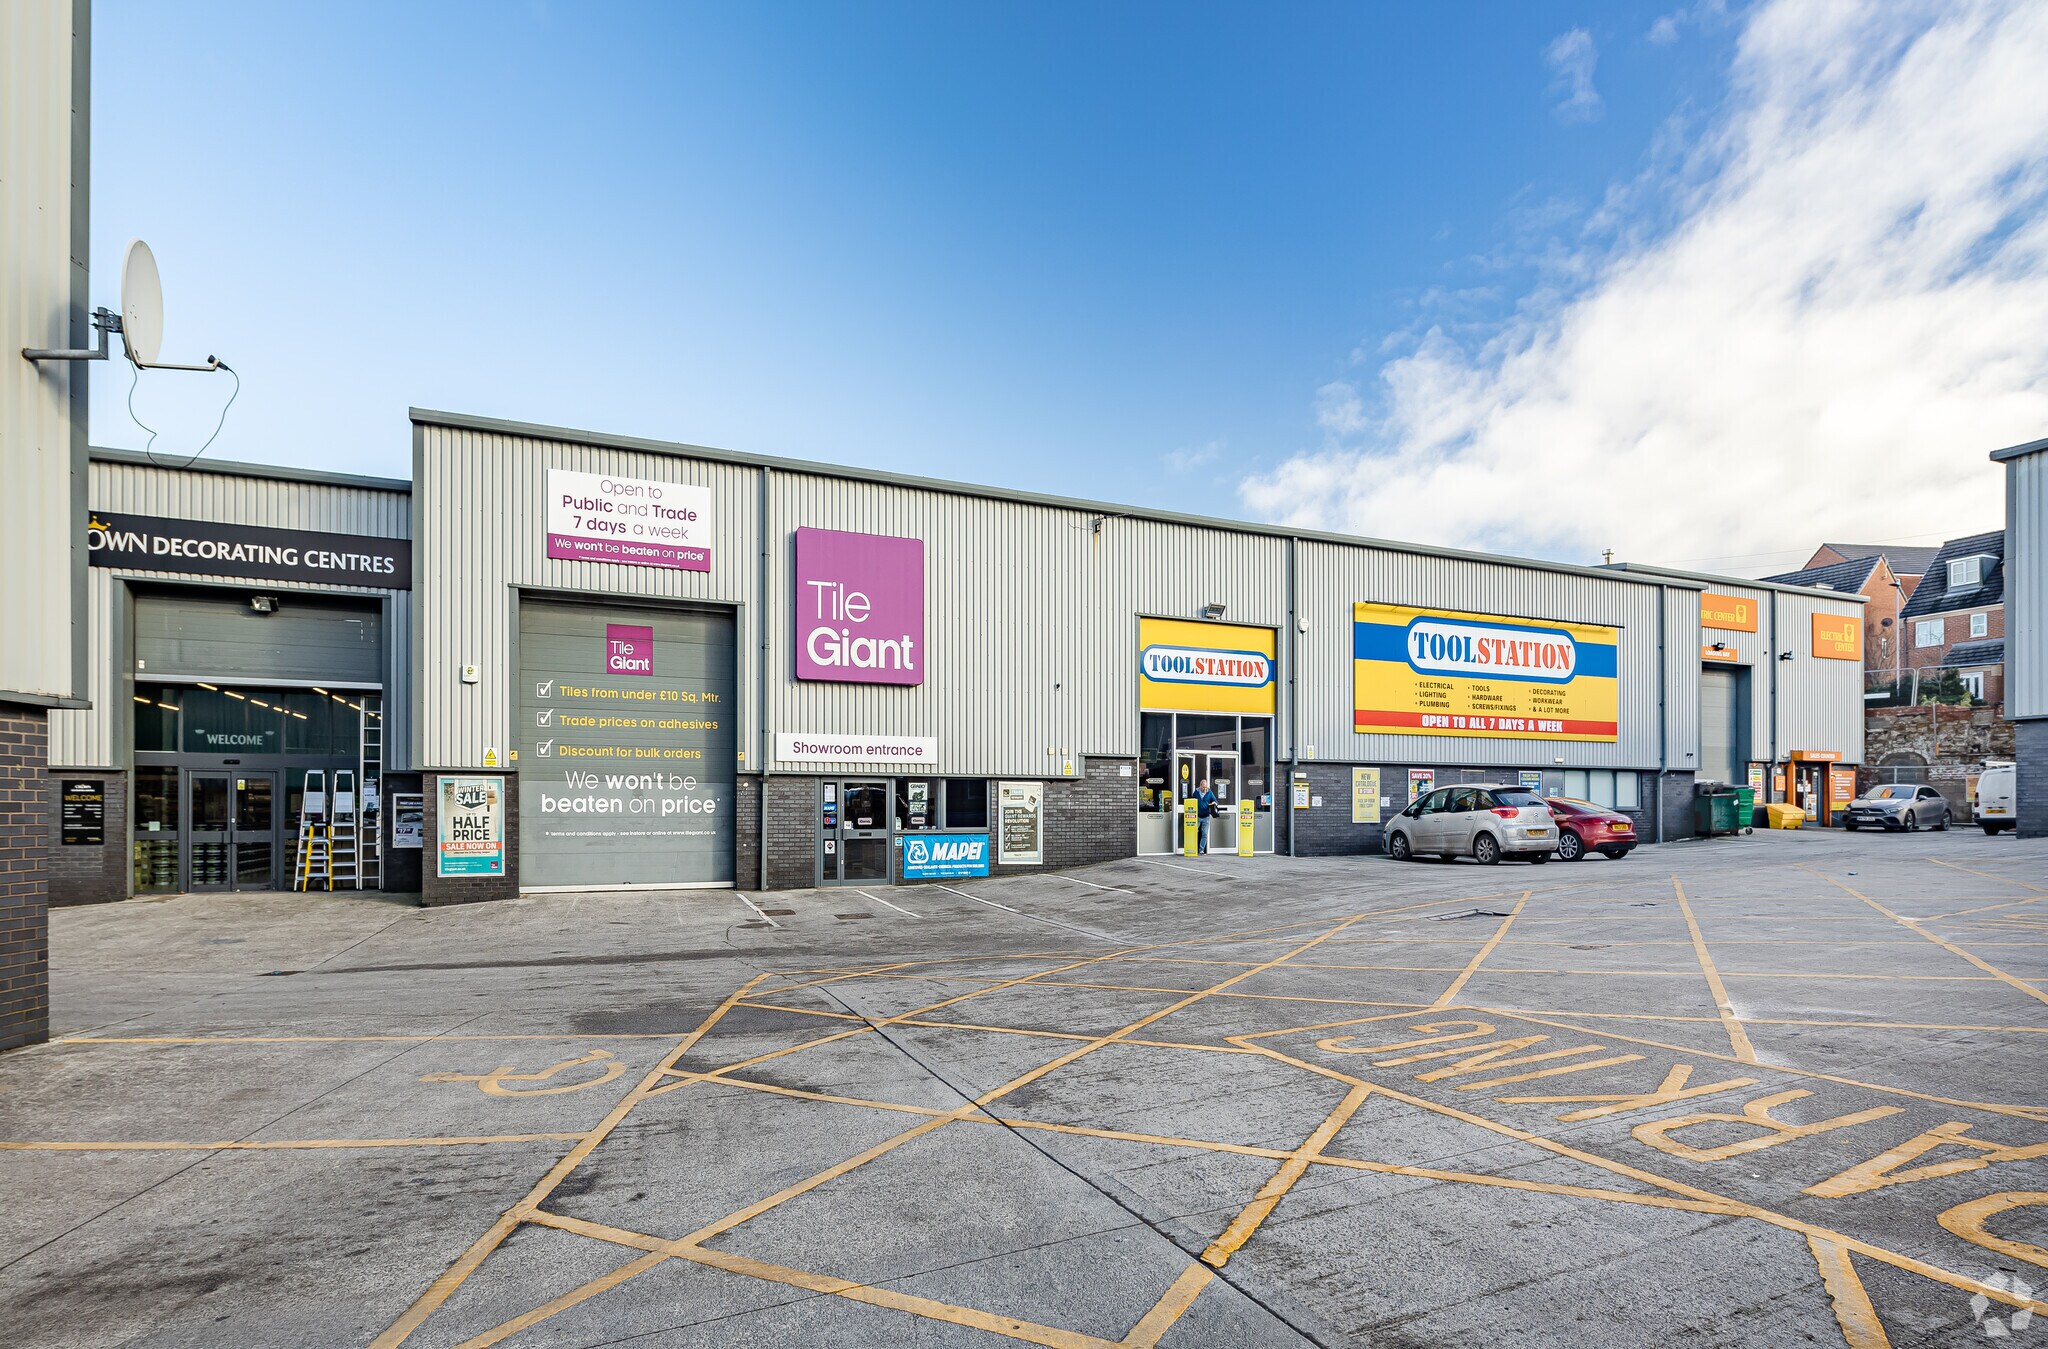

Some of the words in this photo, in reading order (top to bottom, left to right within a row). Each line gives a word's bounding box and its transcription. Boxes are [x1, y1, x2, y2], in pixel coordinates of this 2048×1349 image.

[600, 480, 643, 496] Open
[648, 486, 662, 499] to
[563, 495, 613, 512] Public
[618, 504, 648, 516] and
[652, 504, 697, 522] Trade
[573, 516, 582, 528] 7
[586, 518, 626, 534] days
[633, 524, 643, 535] a
[648, 526, 688, 539] week
[153, 536, 298, 566] DECORATING
[304, 550, 395, 574] CENTRES
[555, 538, 571, 549] We
[574, 541, 603, 551] won't
[606, 543, 619, 553] be
[622, 545, 660, 557] beaten
[662, 550, 674, 558] on
[806, 580, 870, 622] Tile
[1714, 612, 1735, 622] CENTER
[610, 640, 634, 654] Tile
[807, 626, 914, 670] Giant
[1414, 632, 1571, 670] TOOLSTATION
[610, 656, 649, 670] Giant
[1150, 654, 1264, 678] TOOLSTATION
[560, 686, 588, 697] Tiles
[591, 688, 618, 699] from
[622, 689, 656, 700] under
[660, 691, 678, 701] £10
[681, 692, 698, 703] Sq.
[701, 693, 721, 703] Mtr.
[1419, 682, 1454, 690] ELECTRICAL
[1532, 688, 1566, 696] DECORATING
[560, 715, 596, 726] Trade
[599, 718, 637, 729] prices
[658, 719, 718, 729] adhesives
[1422, 715, 1449, 728] OPEN
[1453, 716, 1466, 729] TO
[1469, 717, 1486, 729] ALL
[1490, 718, 1495, 729] 7
[1498, 718, 1524, 730] DAYS
[1528, 720, 1534, 731] A
[1538, 720, 1563, 732] WEEK
[207, 734, 263, 745] WELCOME
[559, 746, 613, 757] Discount
[616, 746, 632, 757] for
[636, 747, 660, 758] bulk
[664, 748, 701, 759] orders
[793, 742, 862, 755] Showroom
[866, 744, 923, 756] entrance
[565, 770, 599, 790] We
[605, 772, 663, 790] won't
[669, 772, 696, 791] be
[456, 791, 486, 805] SALE
[541, 794, 622, 813] beaten
[629, 798, 655, 813] on
[453, 816, 490, 828] HALF
[453, 829, 490, 840] PRICE
[932, 842, 983, 861] MAPEI
